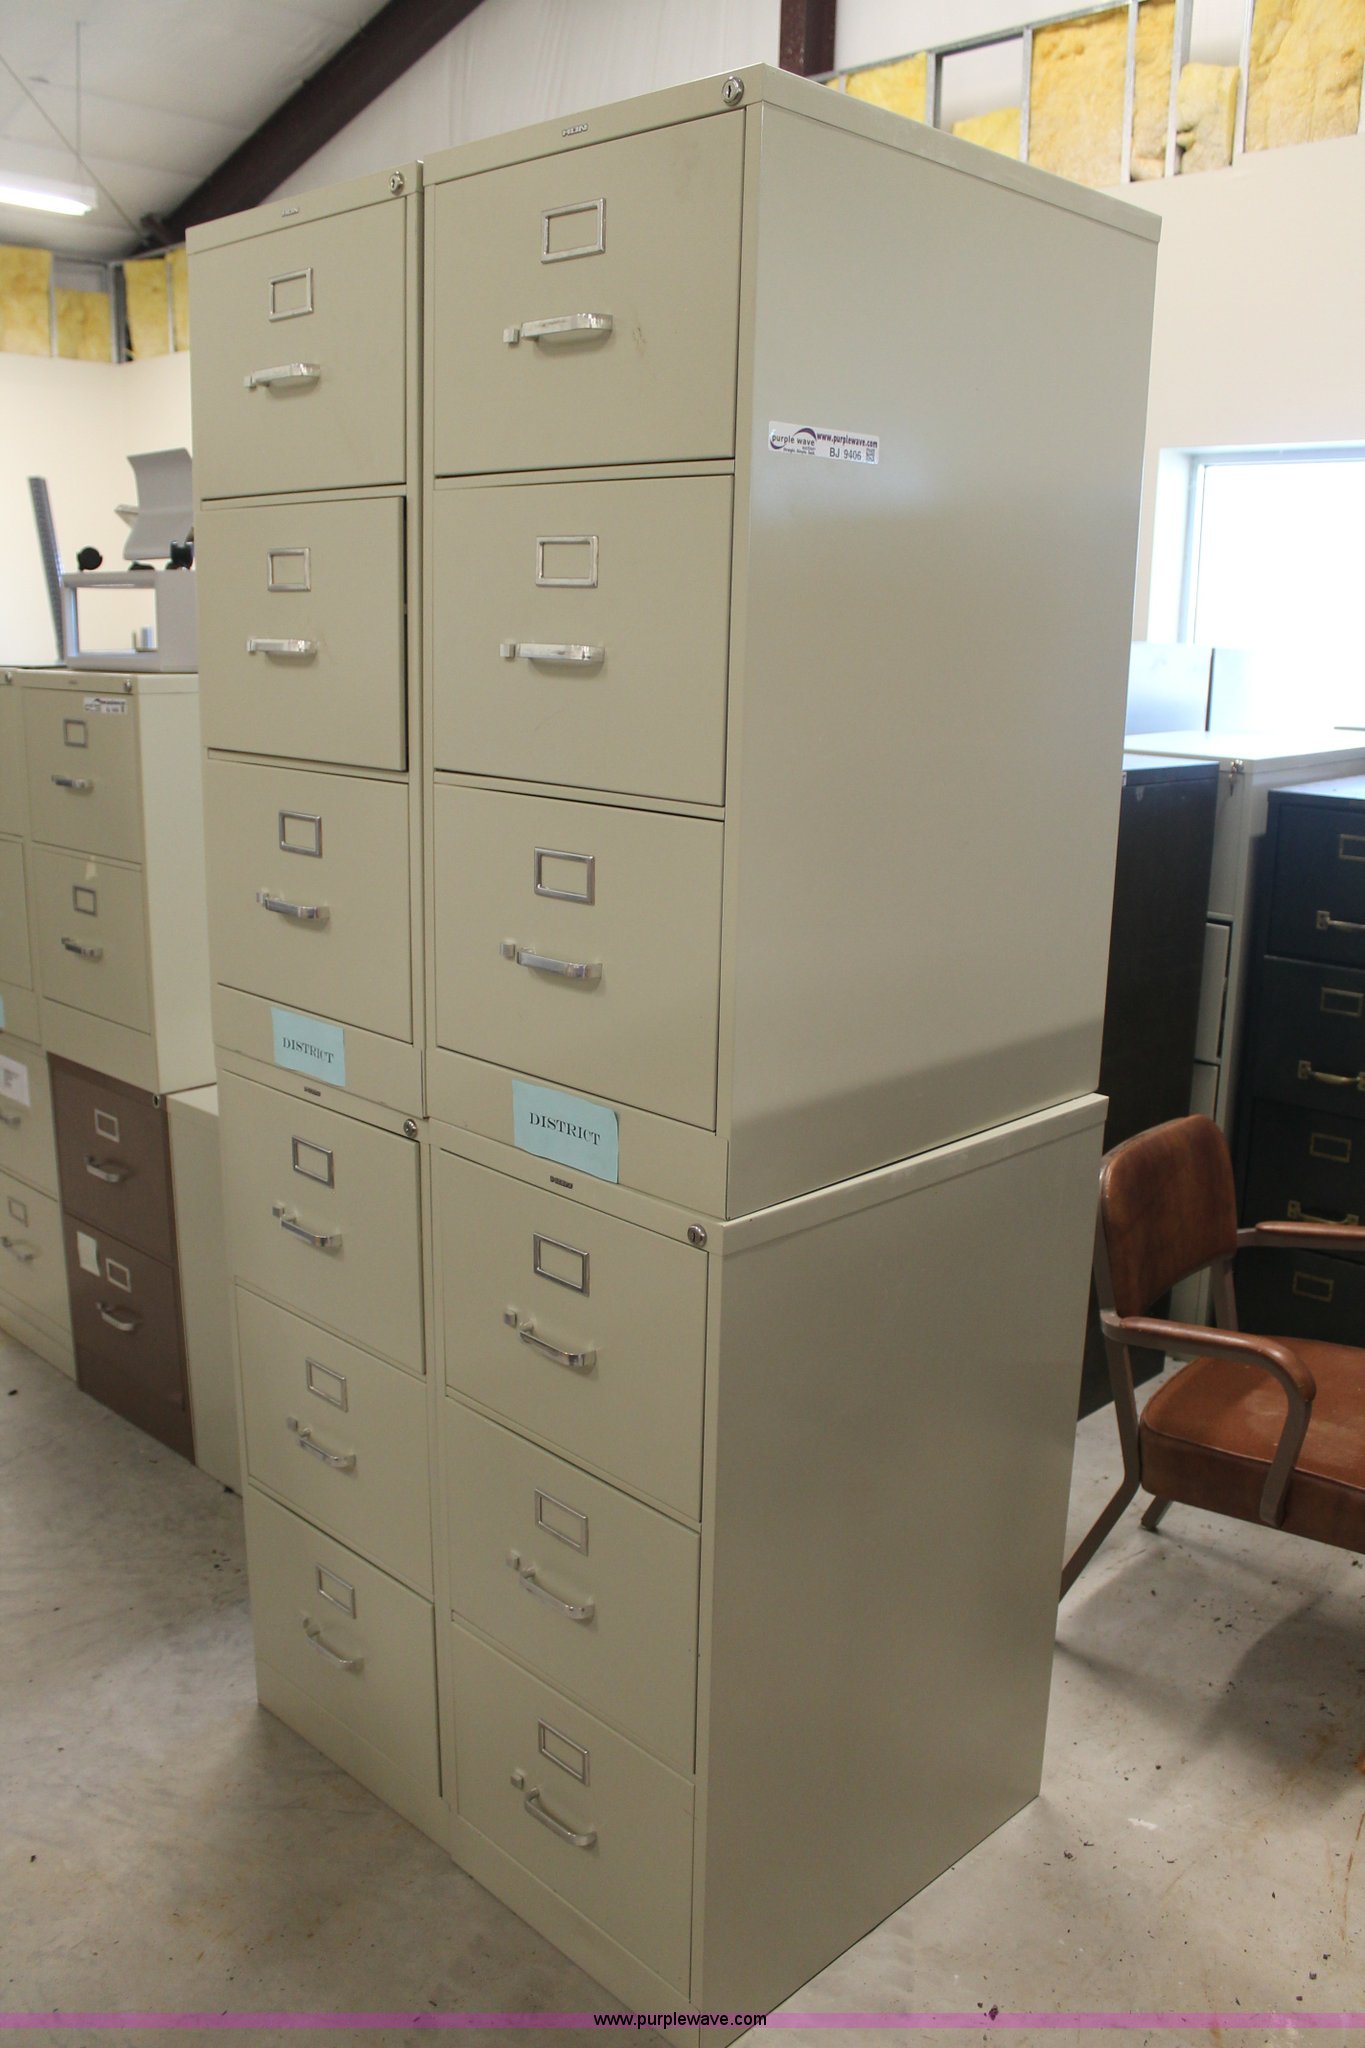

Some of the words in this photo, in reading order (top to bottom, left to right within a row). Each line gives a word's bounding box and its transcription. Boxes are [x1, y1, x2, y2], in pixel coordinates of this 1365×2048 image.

[772, 434, 795, 444] purple
[797, 438, 815, 447] wave
[817, 433, 878, 448] www.purplewave.com
[829, 447, 840, 458] BJ
[843, 448, 862, 461] 9406
[282, 1037, 334, 1064] DISTRICT
[529, 1111, 600, 1146] DISTRICT
